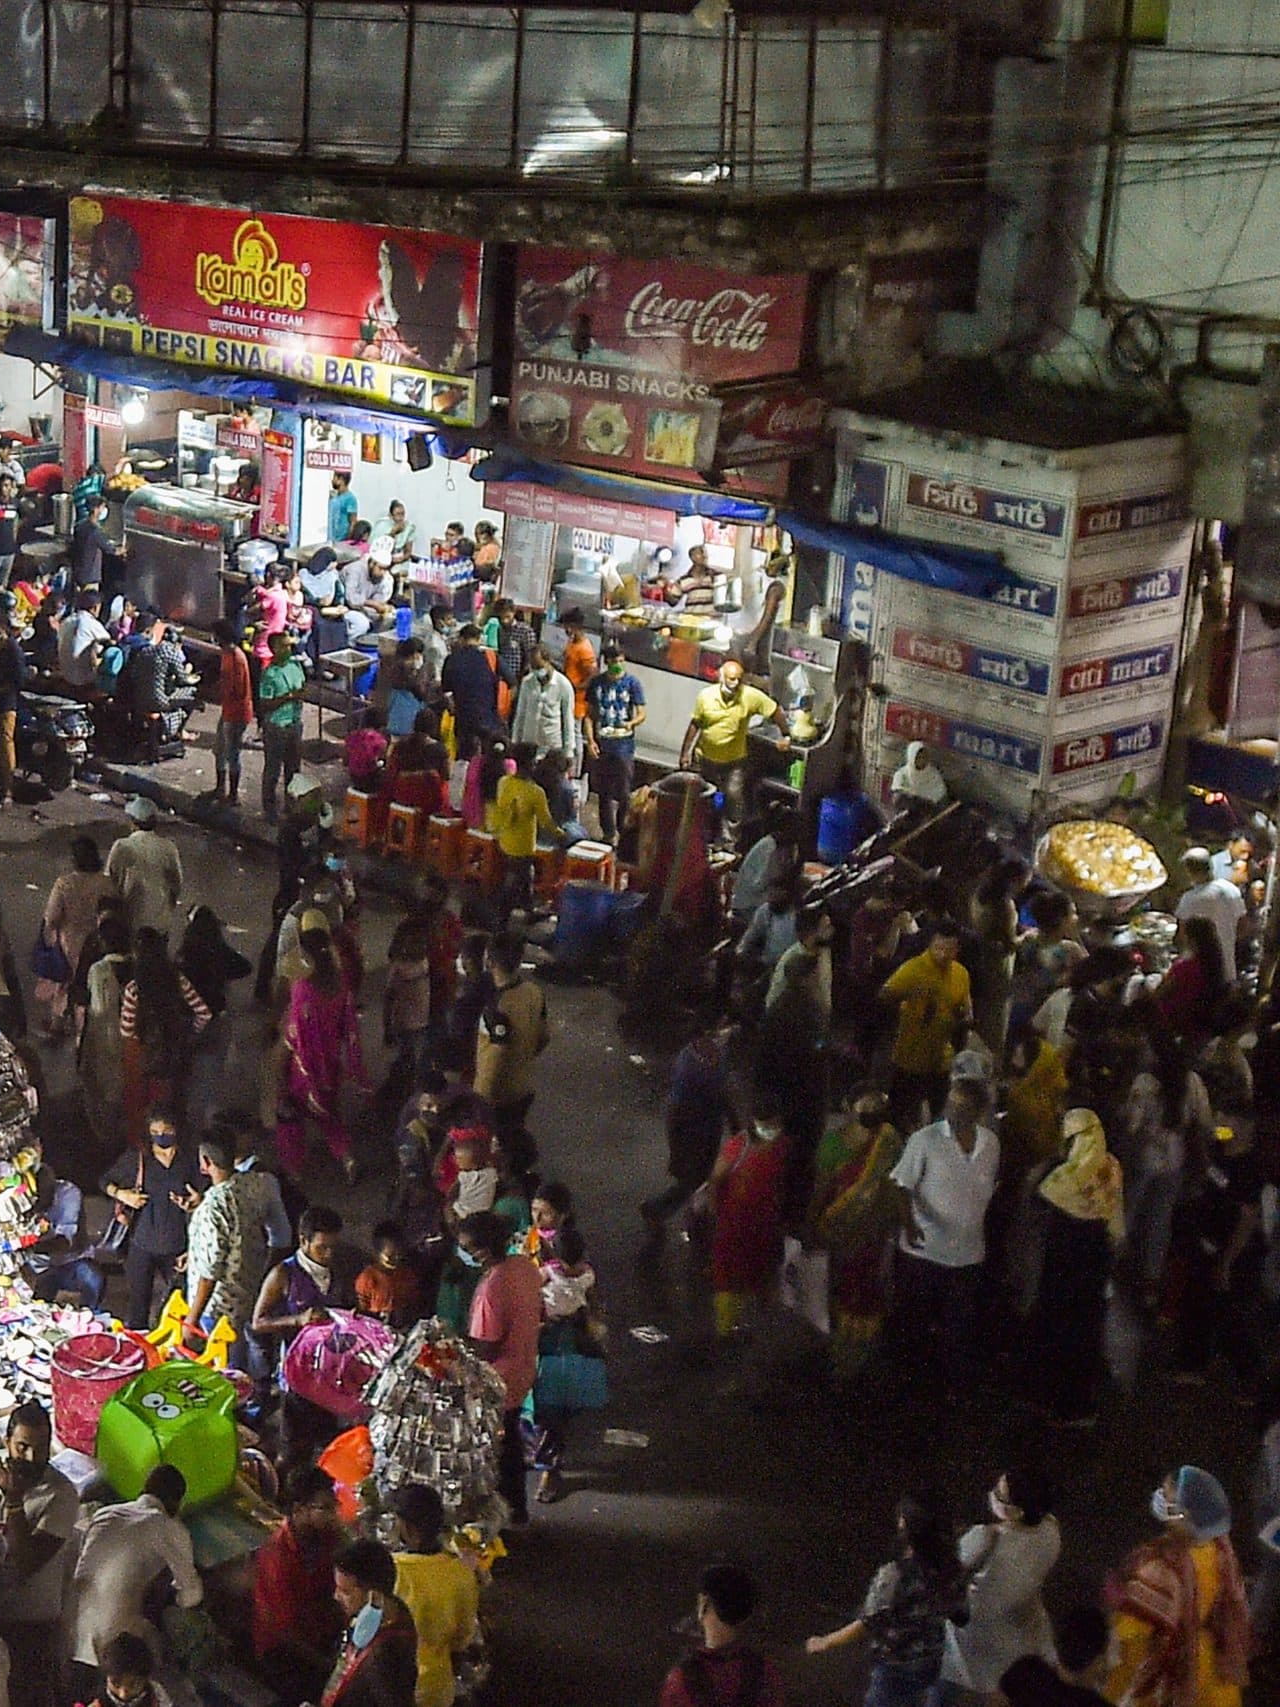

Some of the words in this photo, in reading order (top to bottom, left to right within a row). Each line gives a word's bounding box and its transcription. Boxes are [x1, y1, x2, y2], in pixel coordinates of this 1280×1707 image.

[222, 304, 248, 319] REAL
[249, 308, 266, 321] ICE
[268, 311, 305, 326] CREAM
[141, 328, 208, 362] PEPSI
[215, 341, 315, 382] SNACKS
[324, 360, 377, 391] BAR
[518, 361, 611, 391] PUNJABI
[616, 375, 712, 402] SNACKS
[307, 452, 329, 466] COLD
[574, 530, 593, 551] COLD
[1069, 659, 1104, 690] citi
[1111, 651, 1166, 682] mart
[952, 728, 1027, 768] mart
